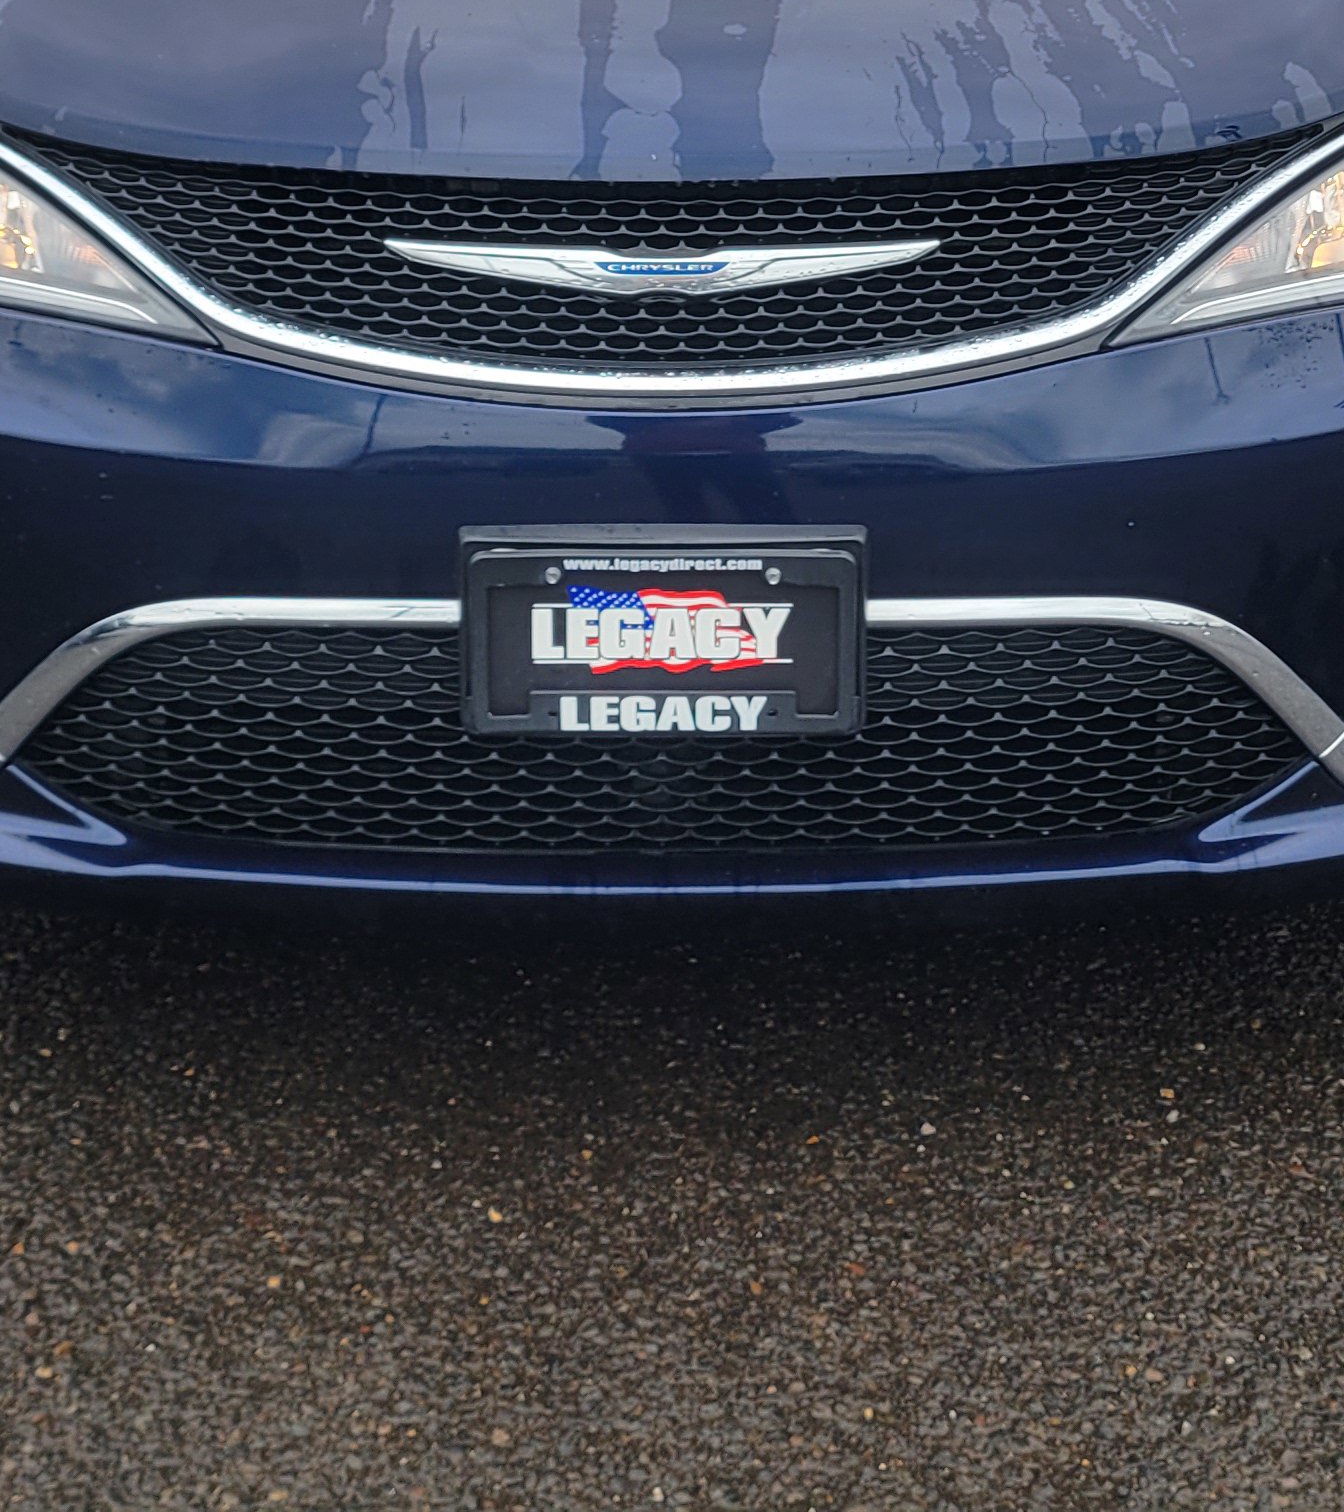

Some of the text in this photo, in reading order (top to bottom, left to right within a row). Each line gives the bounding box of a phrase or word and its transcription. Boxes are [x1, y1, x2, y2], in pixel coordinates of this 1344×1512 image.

[562, 558, 764, 572] www.legacydirect.com
[531, 607, 792, 660] LEGACY
[560, 696, 768, 732] LEGACY
